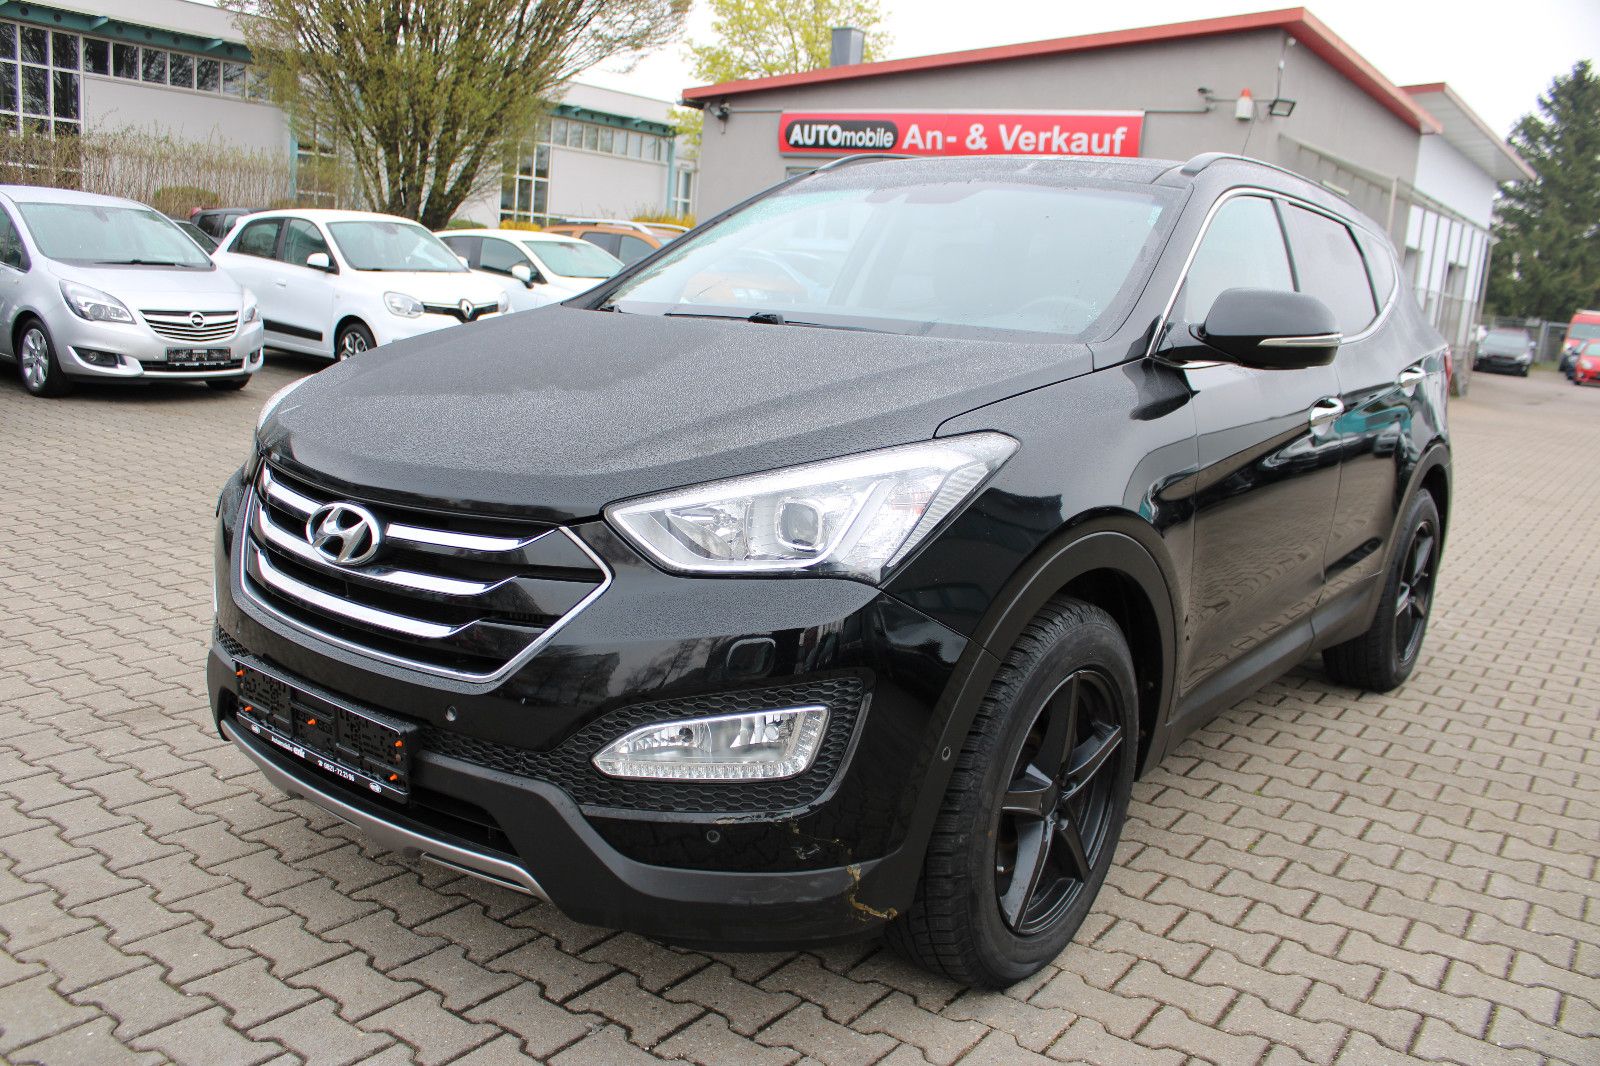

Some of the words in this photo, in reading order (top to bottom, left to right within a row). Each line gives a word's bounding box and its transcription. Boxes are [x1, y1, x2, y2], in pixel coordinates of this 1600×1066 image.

[788, 124, 894, 148] AUTOmobile
[965, 123, 989, 150] &
[998, 123, 1129, 155] Verkauf
